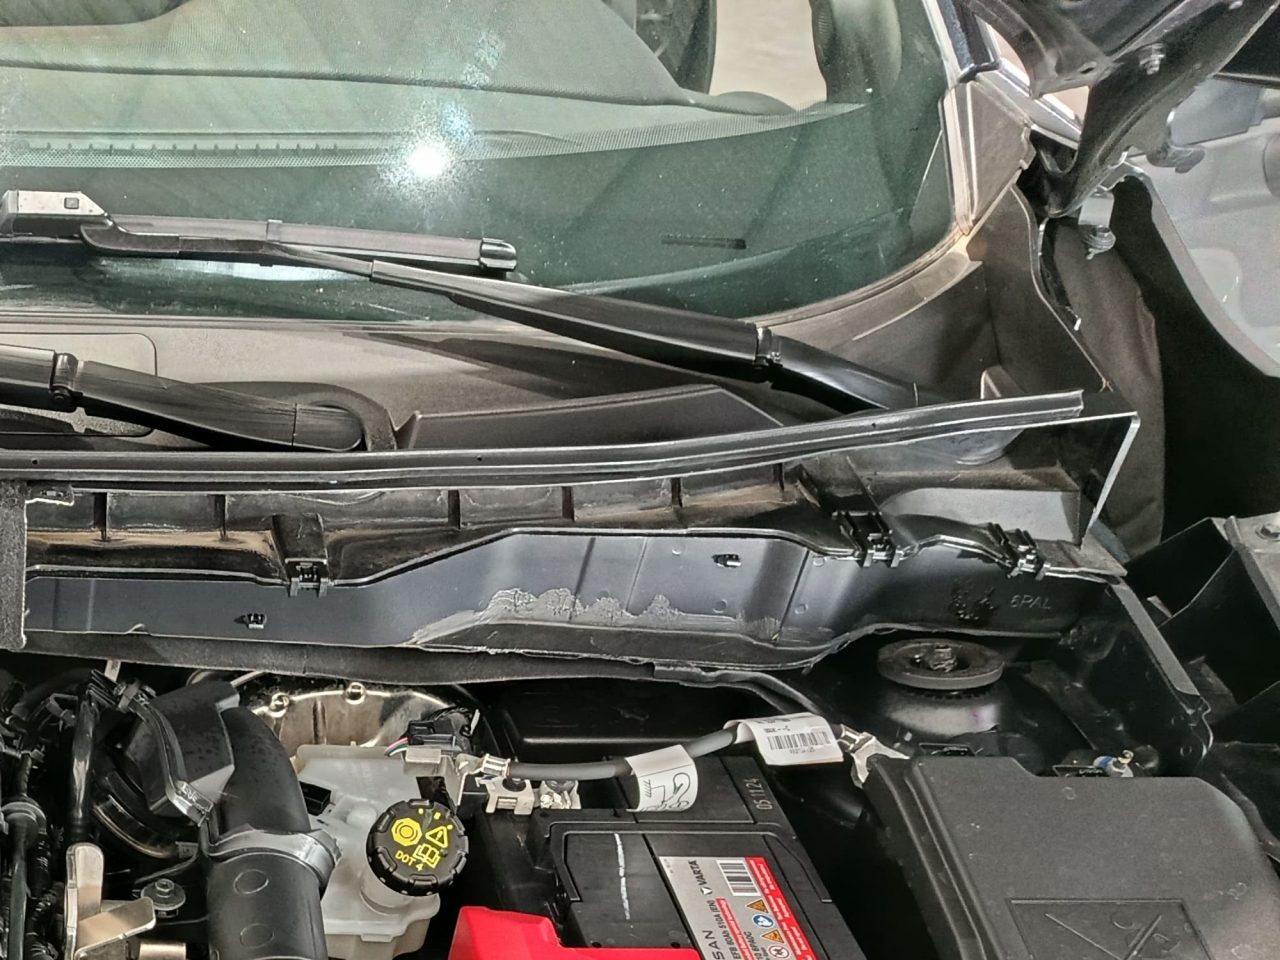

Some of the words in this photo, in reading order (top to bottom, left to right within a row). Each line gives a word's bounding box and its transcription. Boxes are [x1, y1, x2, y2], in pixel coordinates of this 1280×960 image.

[395, 850, 416, 866] DOT
[415, 863, 424, 872] 4
[687, 860, 708, 885] VARTA
[728, 947, 741, 959] EFB
